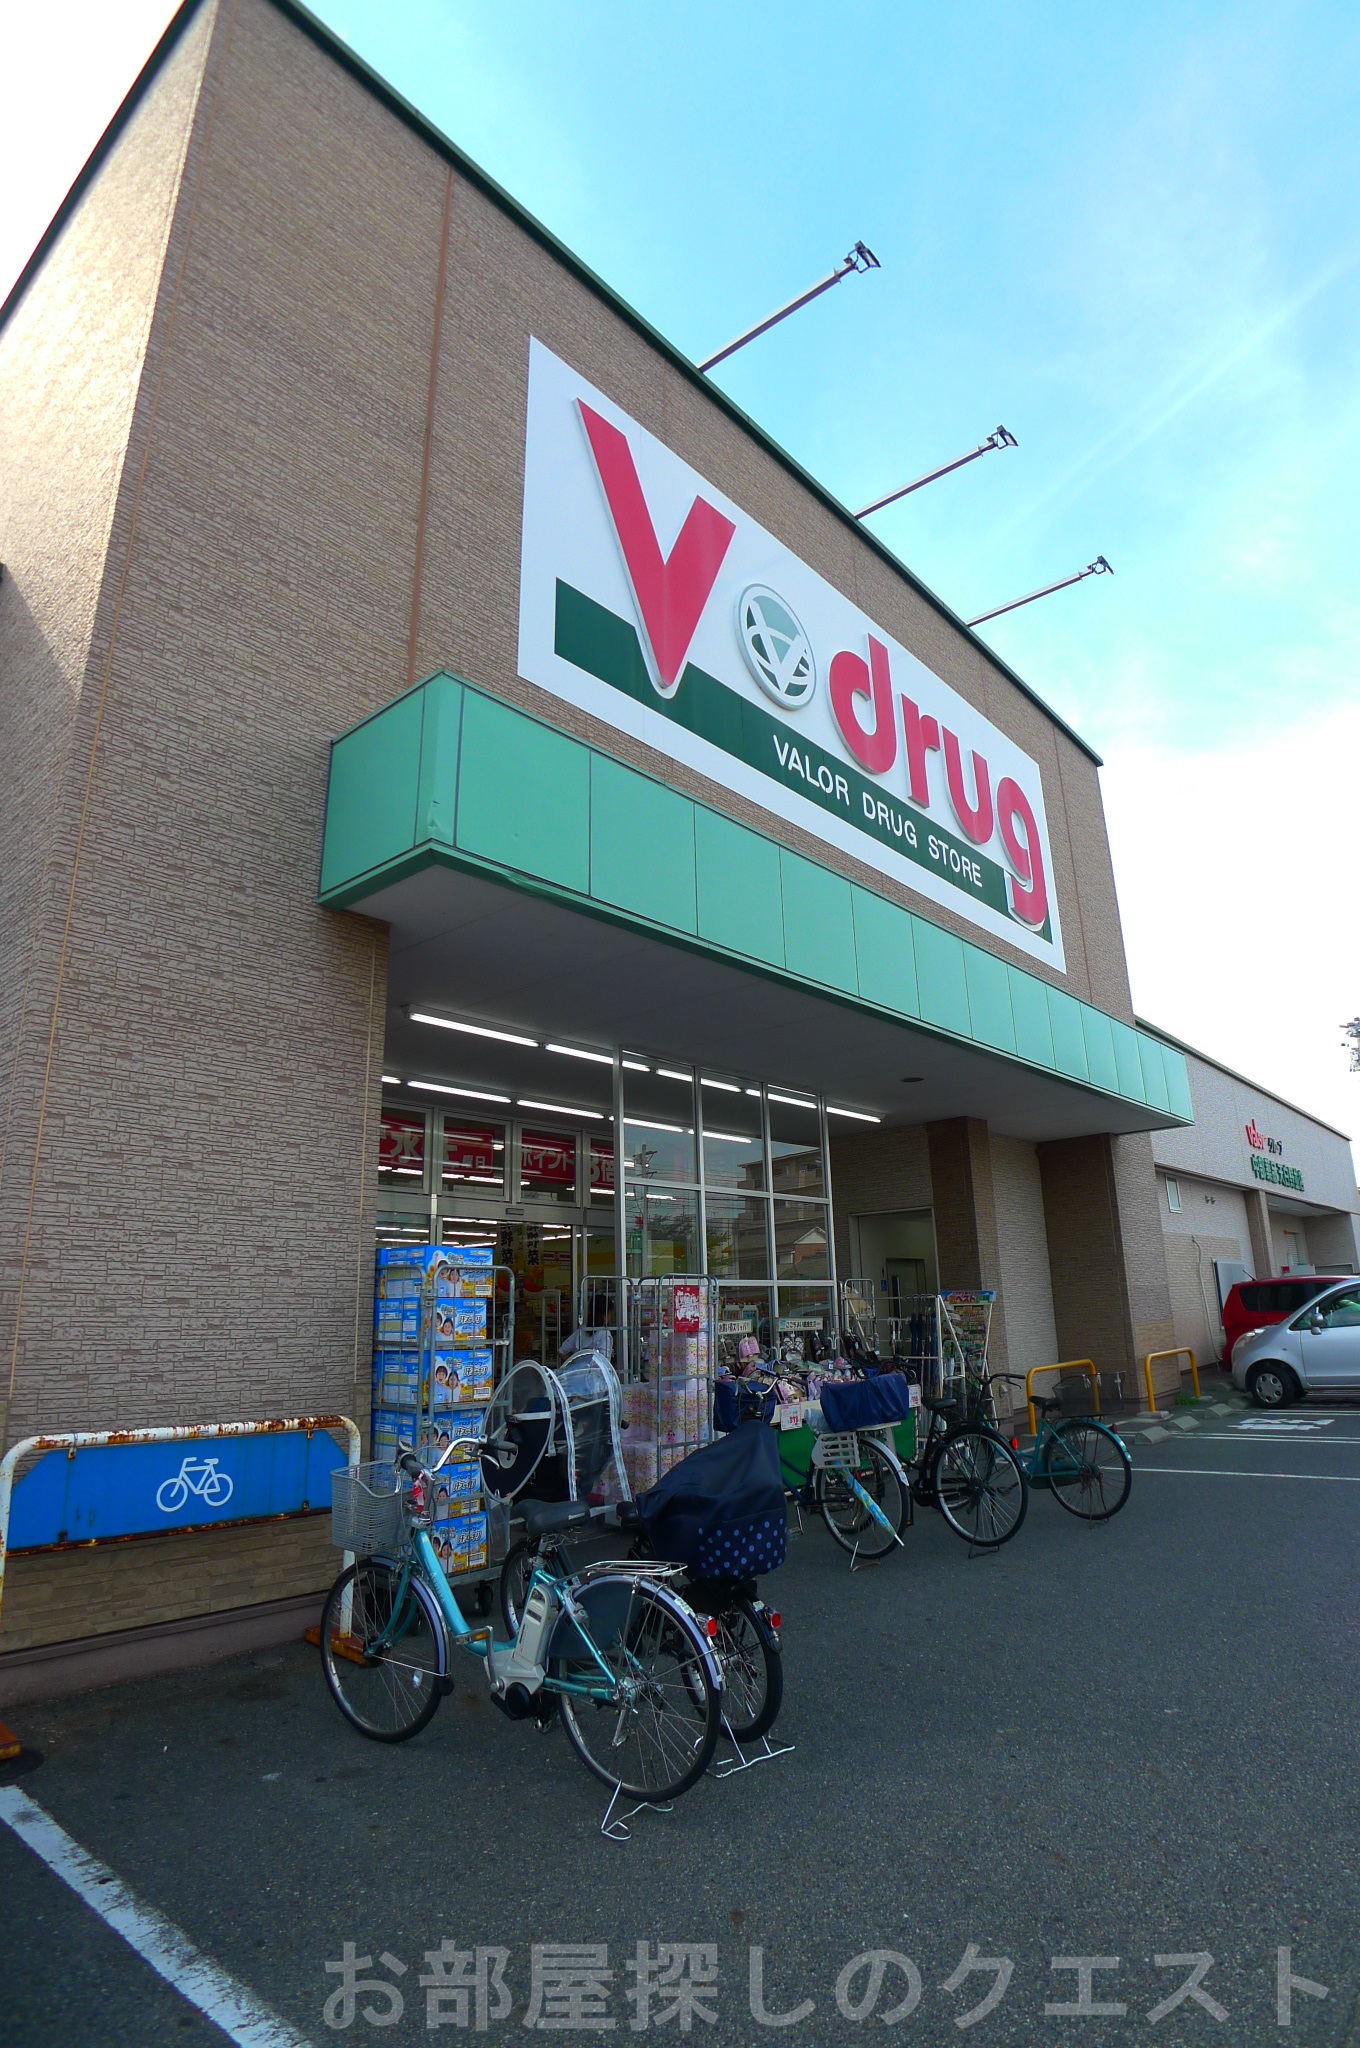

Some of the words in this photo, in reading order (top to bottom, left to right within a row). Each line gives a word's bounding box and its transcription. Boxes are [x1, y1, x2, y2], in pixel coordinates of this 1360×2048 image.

[576, 397, 737, 691] V
[827, 632, 1048, 929] drug
[773, 734, 850, 806] VALOR
[862, 791, 917, 848] DRUG
[928, 835, 983, 887] STORE
